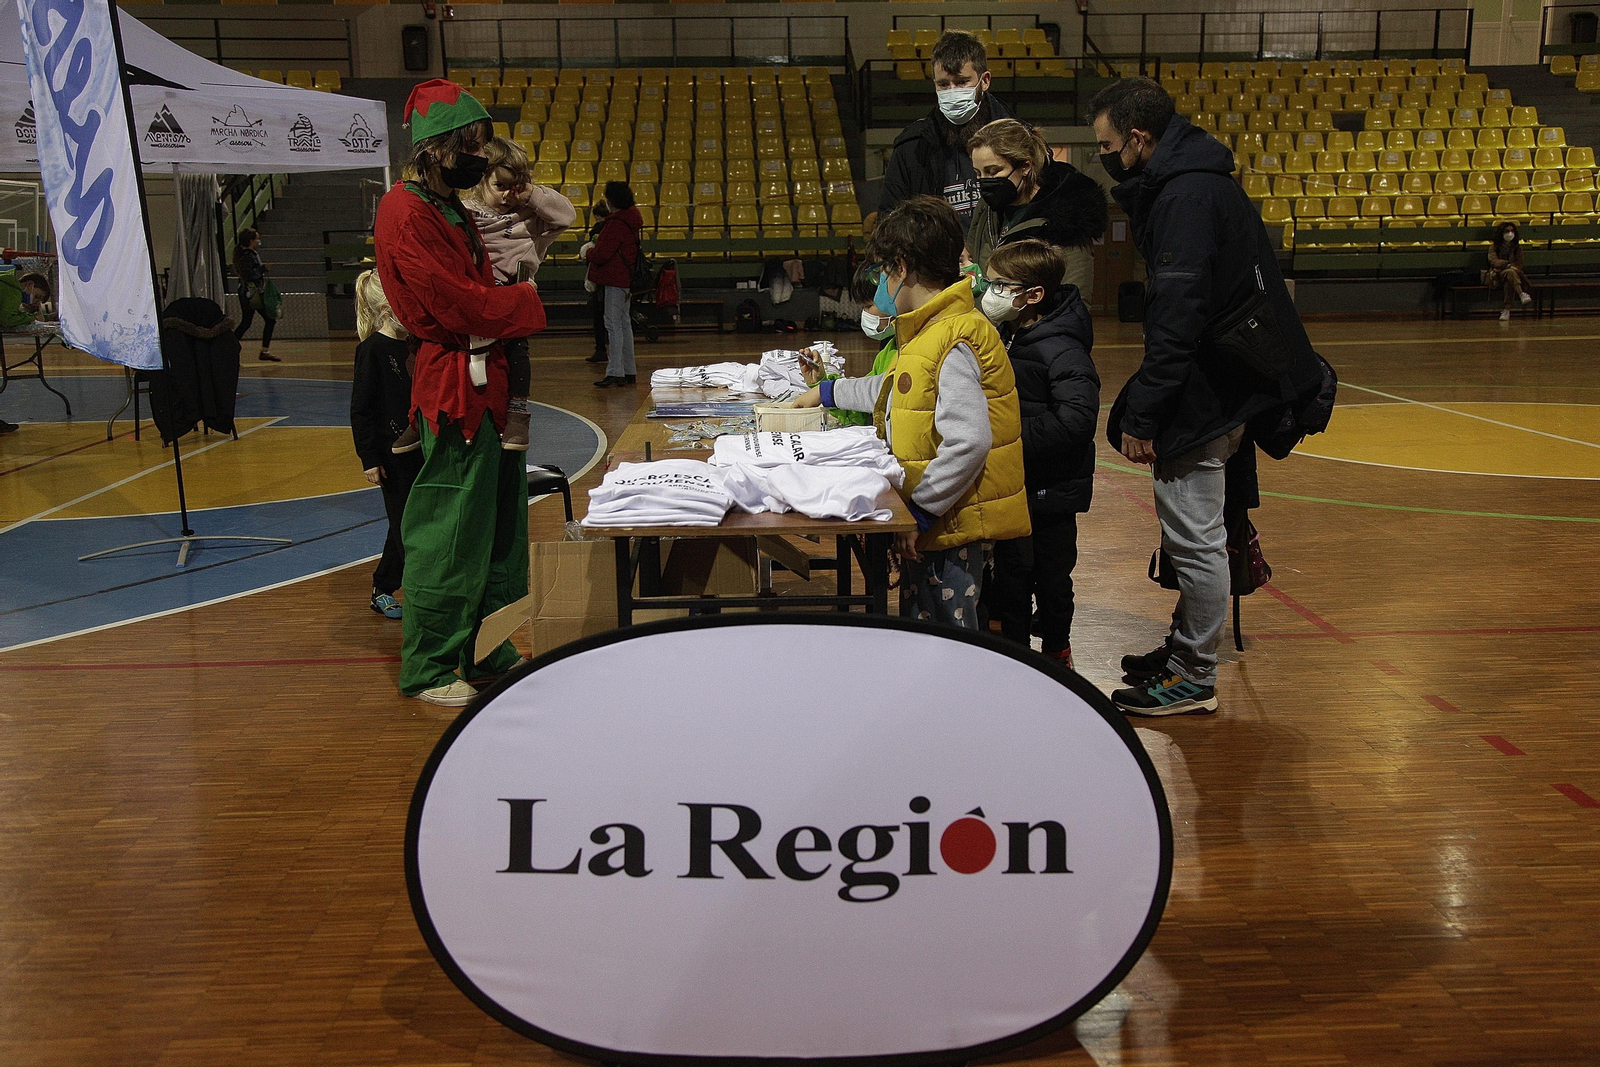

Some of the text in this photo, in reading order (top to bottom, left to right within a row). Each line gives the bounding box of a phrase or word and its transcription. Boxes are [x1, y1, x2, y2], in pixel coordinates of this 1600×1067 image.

[210, 128, 238, 137] MARCHA
[496, 795, 1075, 903] La Región
